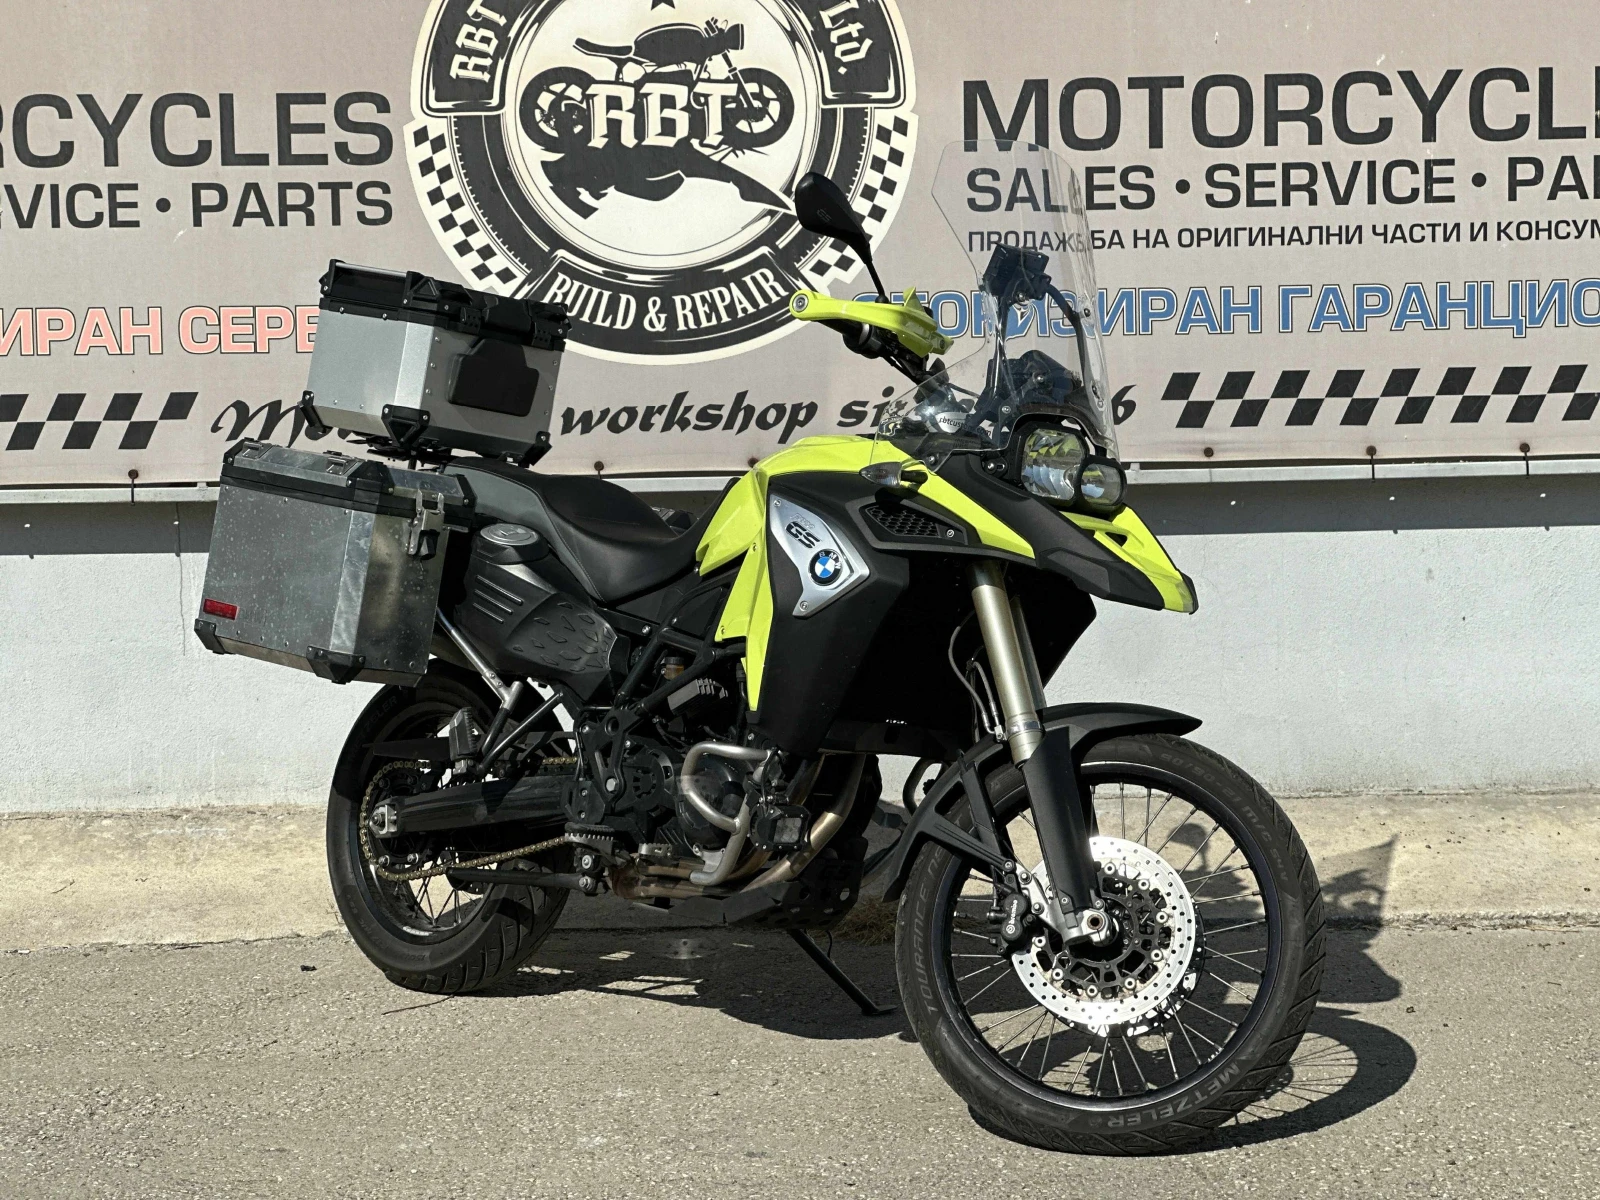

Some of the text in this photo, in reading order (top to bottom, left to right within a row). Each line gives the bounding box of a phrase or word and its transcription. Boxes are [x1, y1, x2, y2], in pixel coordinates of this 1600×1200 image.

[449, 0, 508, 83] RBT
[819, 0, 874, 75] Ltd.
[0, 91, 393, 169] CYCLES
[585, 81, 739, 149] RBT
[963, 66, 1600, 153] MOTORCYCL
[0, 180, 393, 229] VICE PARTS
[966, 154, 1600, 214] SALES SERVICE PA
[1133, 227, 1170, 250] НА
[1177, 225, 1363, 249] ОРИГИНАЛНИ
[1371, 222, 1461, 245] ЧАСТИ
[1469, 221, 1488, 242] И
[544, 267, 789, 332] BUILD & REPAIR
[560, 390, 818, 444] workshop
[786, 520, 821, 549] GS
[913, 881, 939, 1016] TOURANCE
[1107, 1060, 1242, 1129] METZELER
